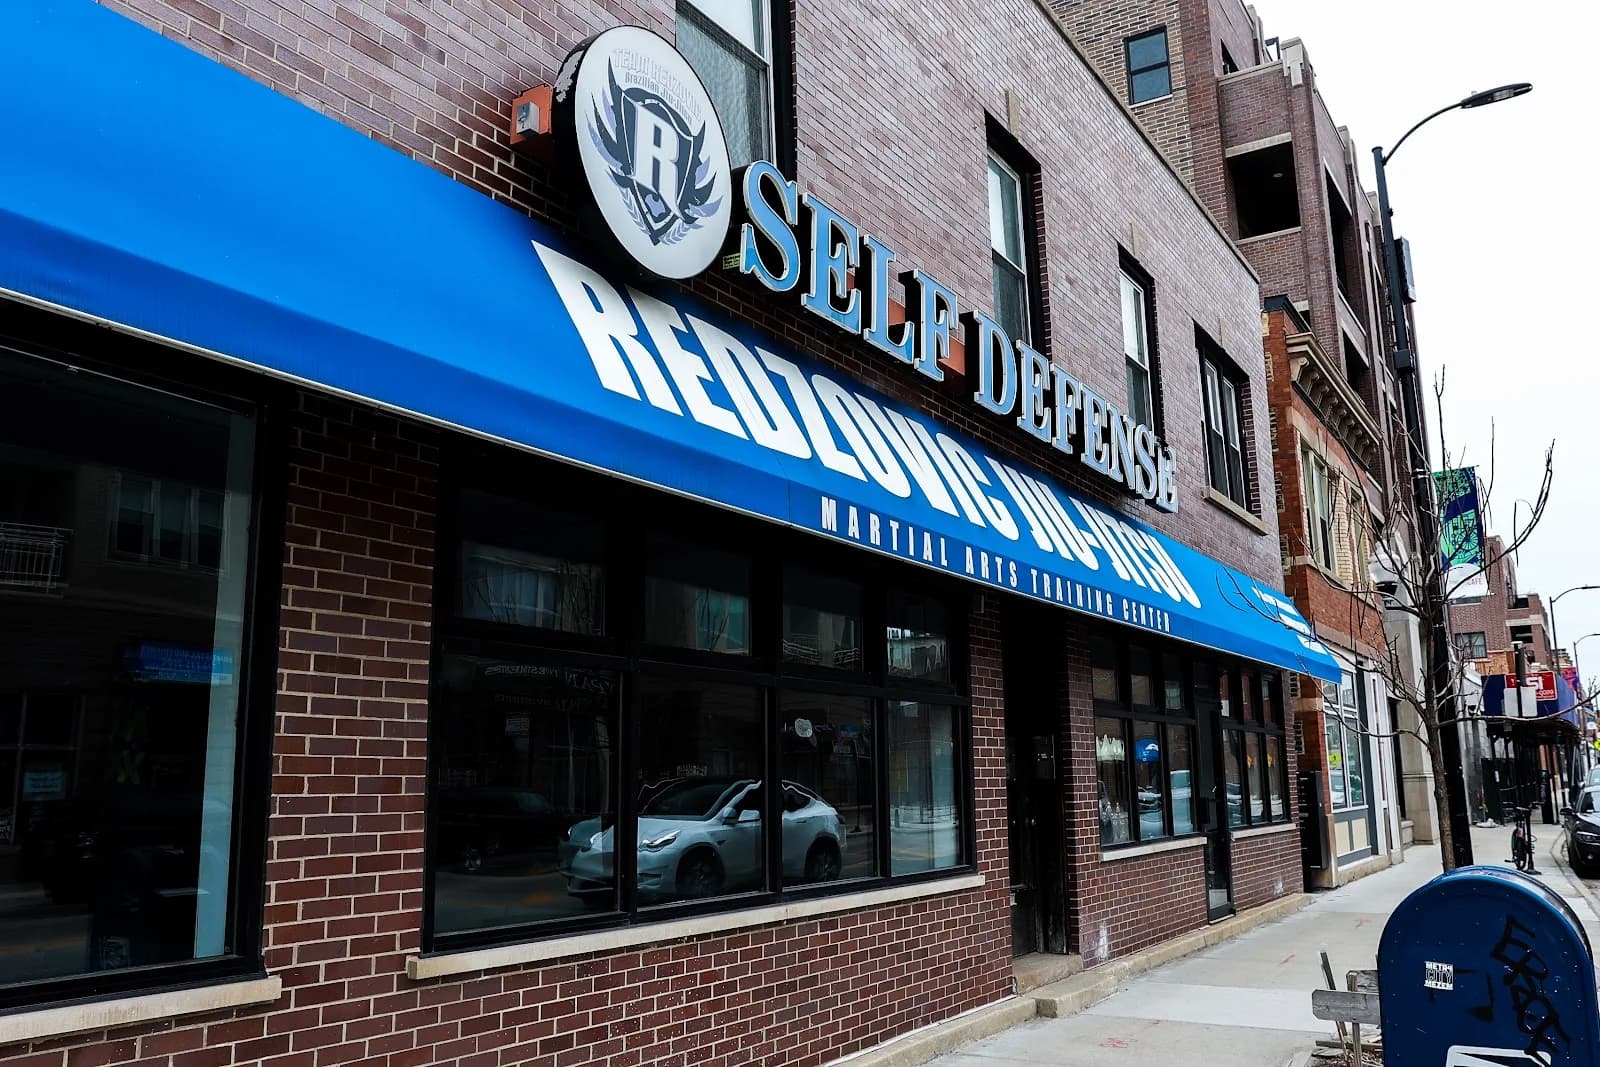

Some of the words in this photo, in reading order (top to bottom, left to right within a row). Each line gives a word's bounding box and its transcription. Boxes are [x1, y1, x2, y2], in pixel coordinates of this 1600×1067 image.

[624, 71, 660, 95] Brazilian
[634, 104, 684, 220] R
[740, 160, 959, 381] SELF
[974, 310, 1179, 513] DEFENSE
[531, 239, 1019, 541] REDZOVIC
[983, 455, 1202, 609] JIU-JITSU
[821, 495, 948, 567] MARTIAL
[965, 546, 1018, 588] ARTS
[1030, 568, 1113, 616] TRAINING
[1122, 598, 1170, 633] CENTER
